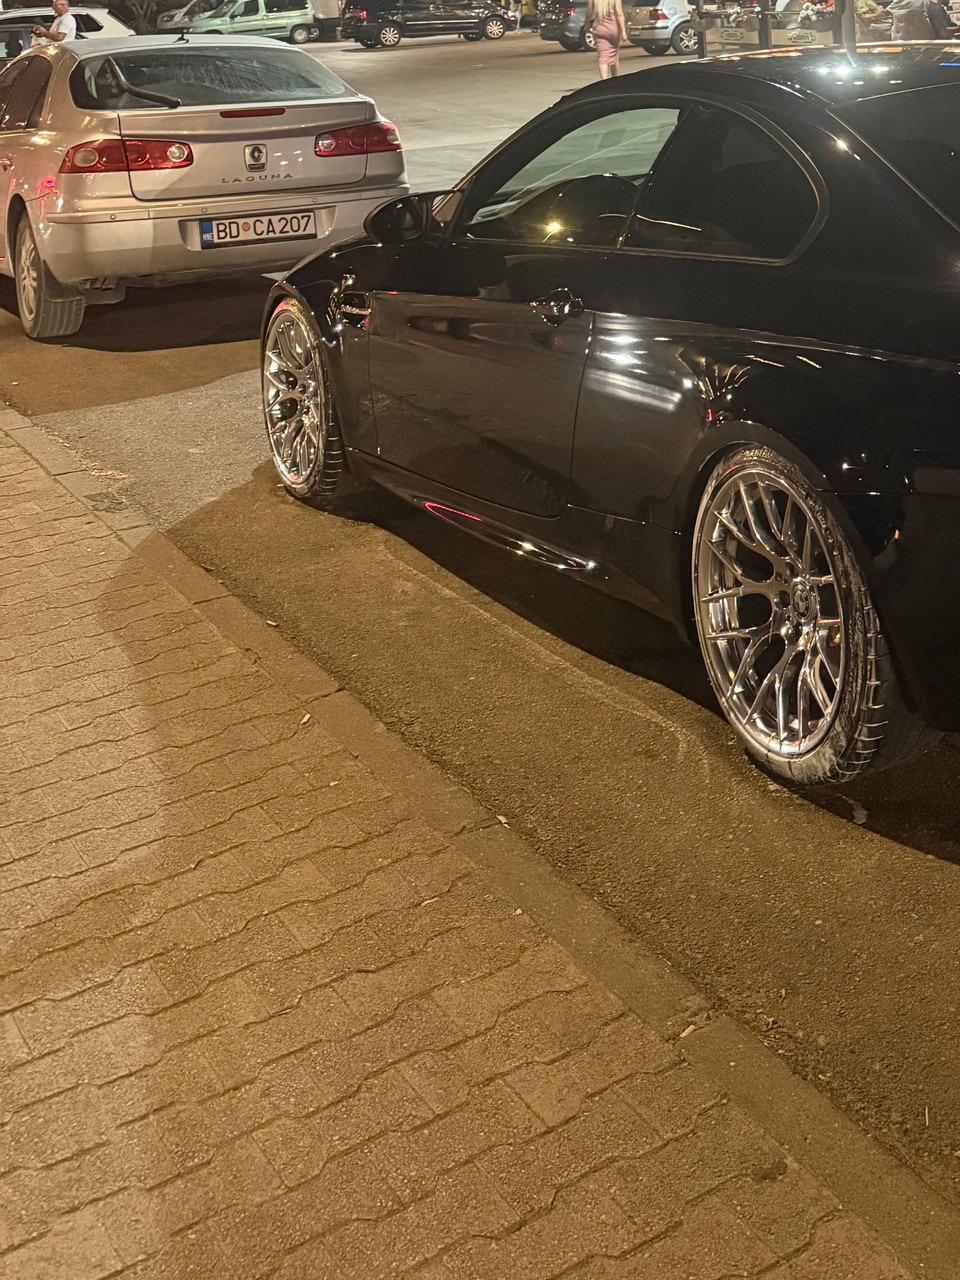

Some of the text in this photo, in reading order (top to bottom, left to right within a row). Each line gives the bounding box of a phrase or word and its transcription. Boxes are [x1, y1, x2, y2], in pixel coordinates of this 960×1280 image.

[221, 173, 293, 183] LAGUNA
[216, 215, 311, 240] BD CA207
